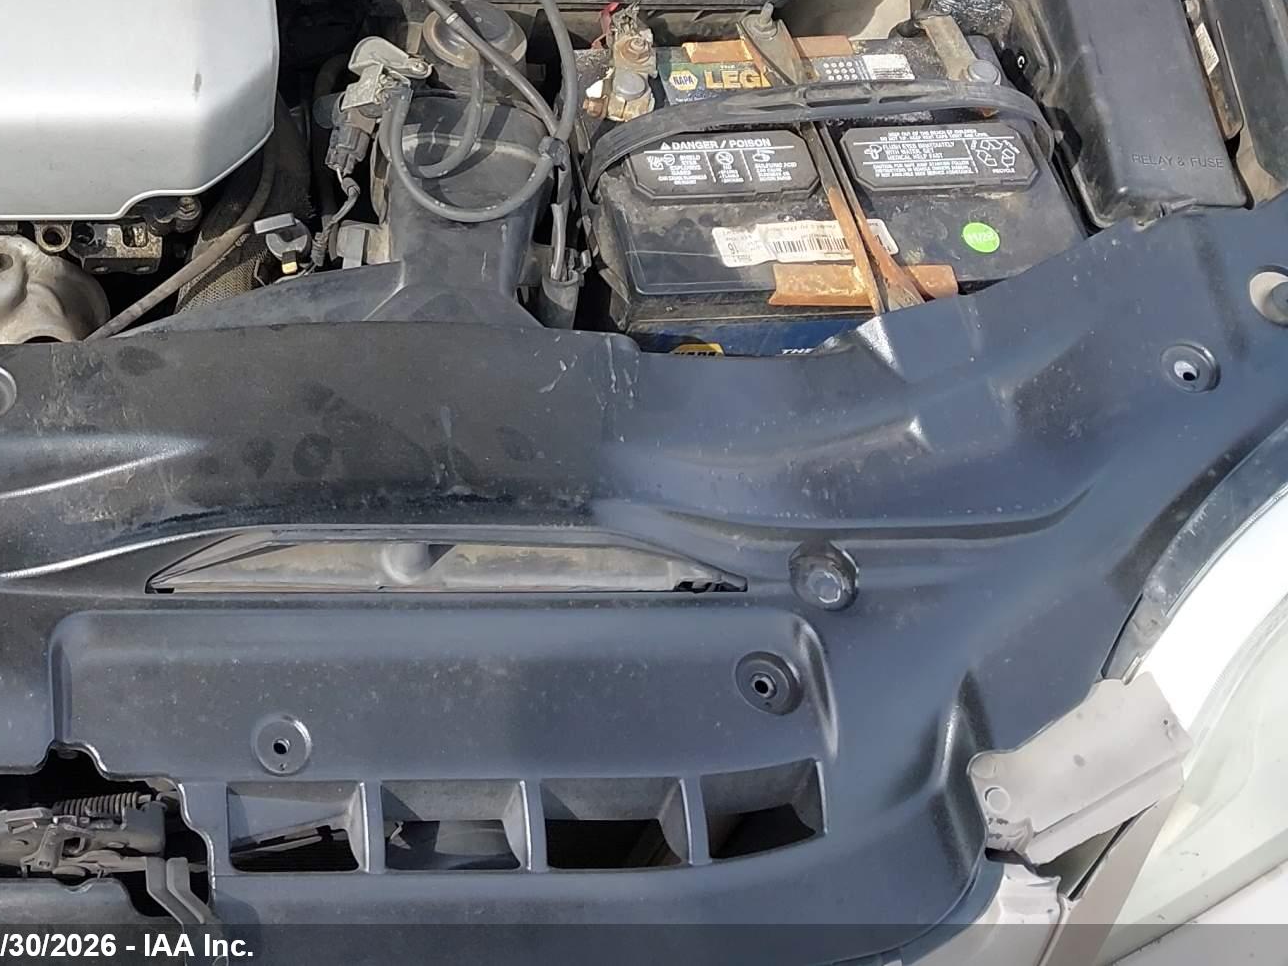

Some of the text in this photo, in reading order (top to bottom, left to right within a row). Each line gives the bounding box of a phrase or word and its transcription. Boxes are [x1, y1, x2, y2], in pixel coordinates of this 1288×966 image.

[673, 75, 694, 85] NAPA
[672, 140, 719, 150] DANGER
[729, 137, 772, 148] POISON
[1131, 153, 1225, 169] RELAY & FUSE
